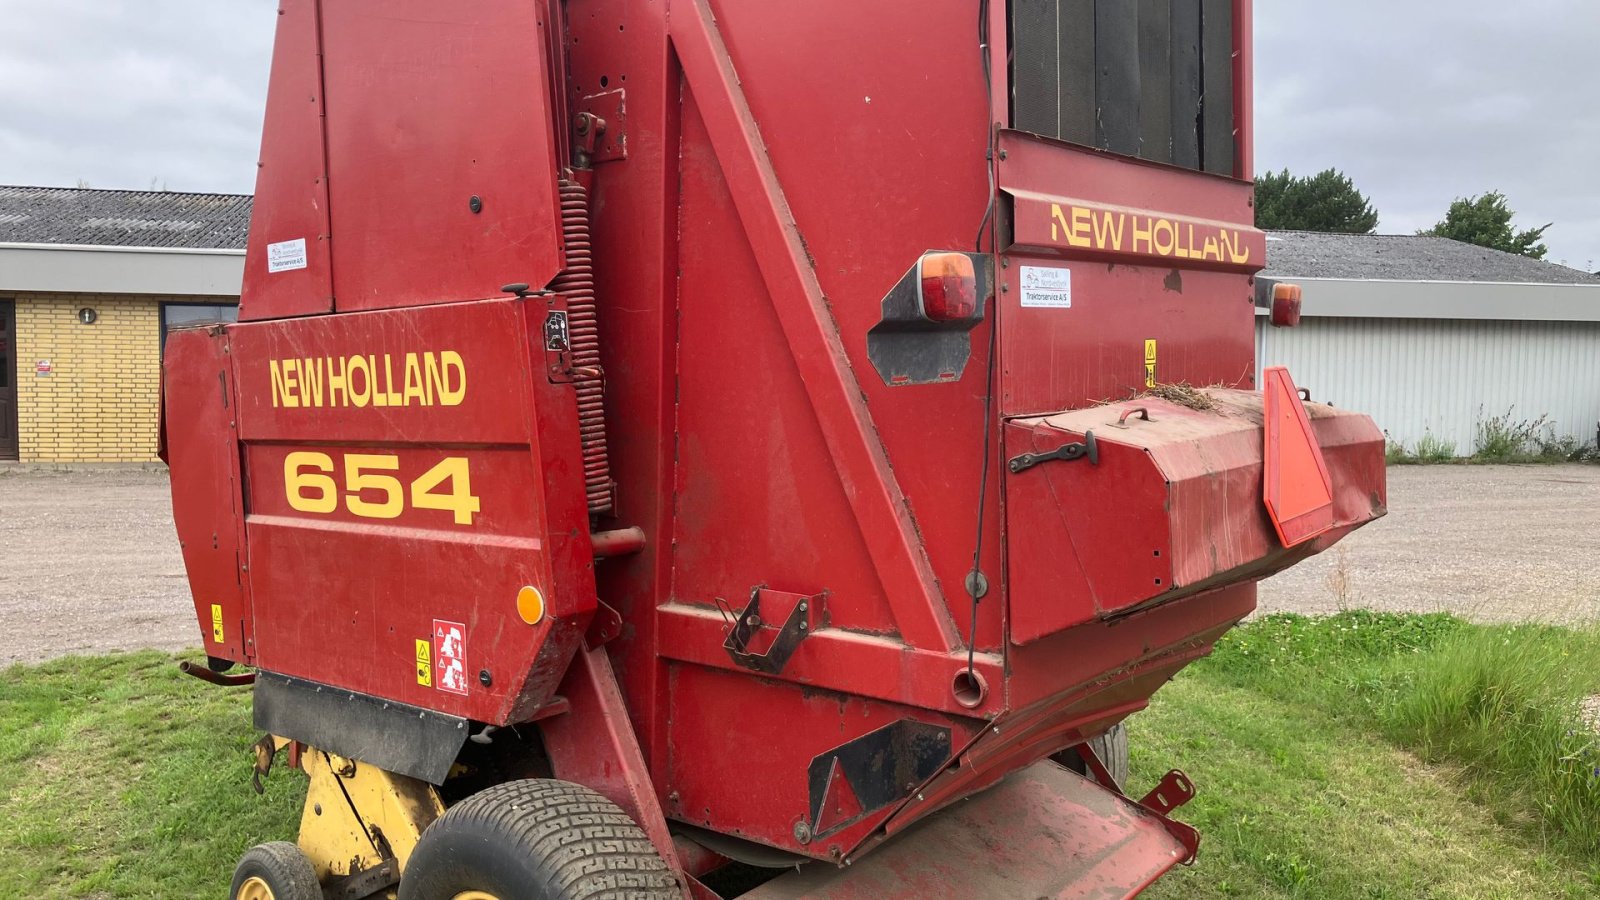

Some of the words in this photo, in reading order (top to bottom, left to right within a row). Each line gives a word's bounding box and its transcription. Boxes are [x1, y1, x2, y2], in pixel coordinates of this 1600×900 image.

[1051, 203, 1125, 251] NEW
[270, 357, 323, 408] NEW
[327, 350, 467, 408] HOLLAND
[283, 451, 481, 525] 654
